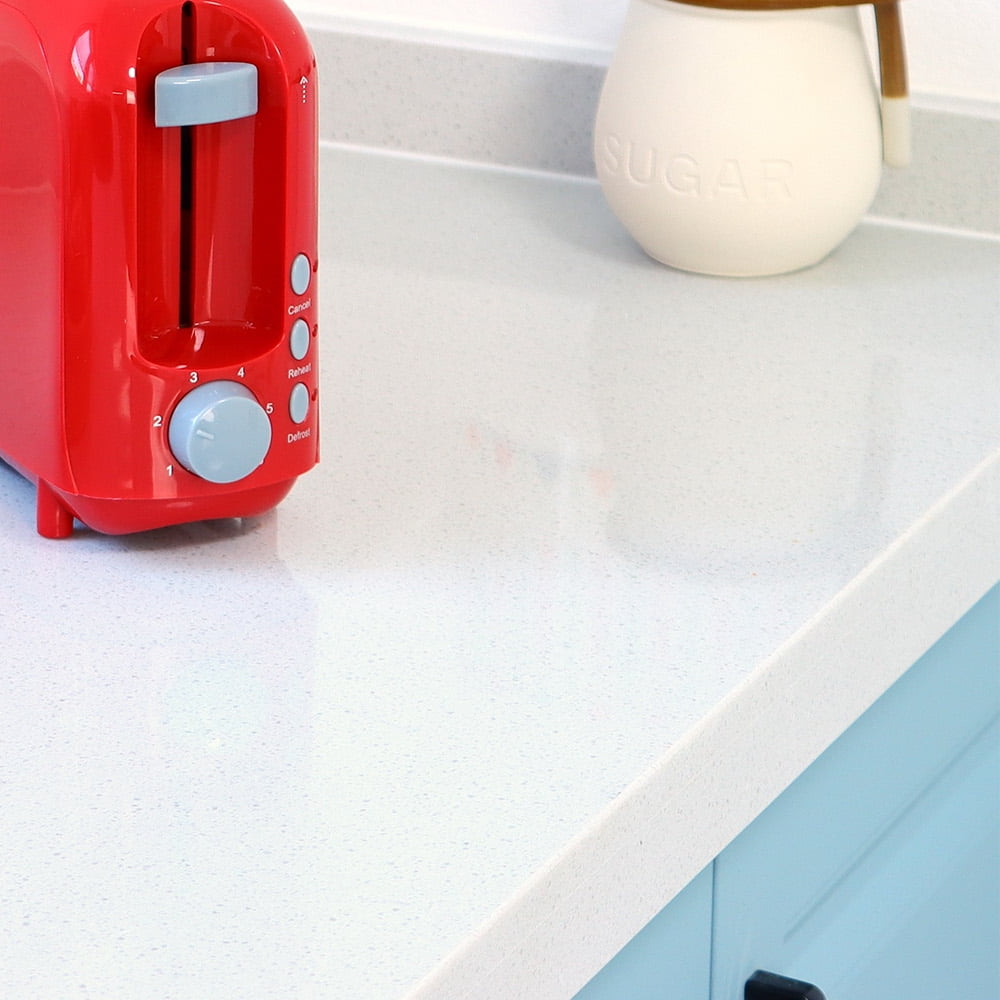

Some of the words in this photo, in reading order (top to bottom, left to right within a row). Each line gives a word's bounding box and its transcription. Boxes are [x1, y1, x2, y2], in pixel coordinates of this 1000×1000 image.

[604, 132, 794, 200] SUGAR
[287, 298, 312, 316] Cancel
[188, 371, 199, 384] 3
[236, 366, 246, 378] 4
[287, 362, 312, 380] Reheat
[265, 402, 274, 414] 5
[152, 415, 163, 428] 2
[286, 427, 312, 445] Defrost
[165, 463, 174, 477] 1
